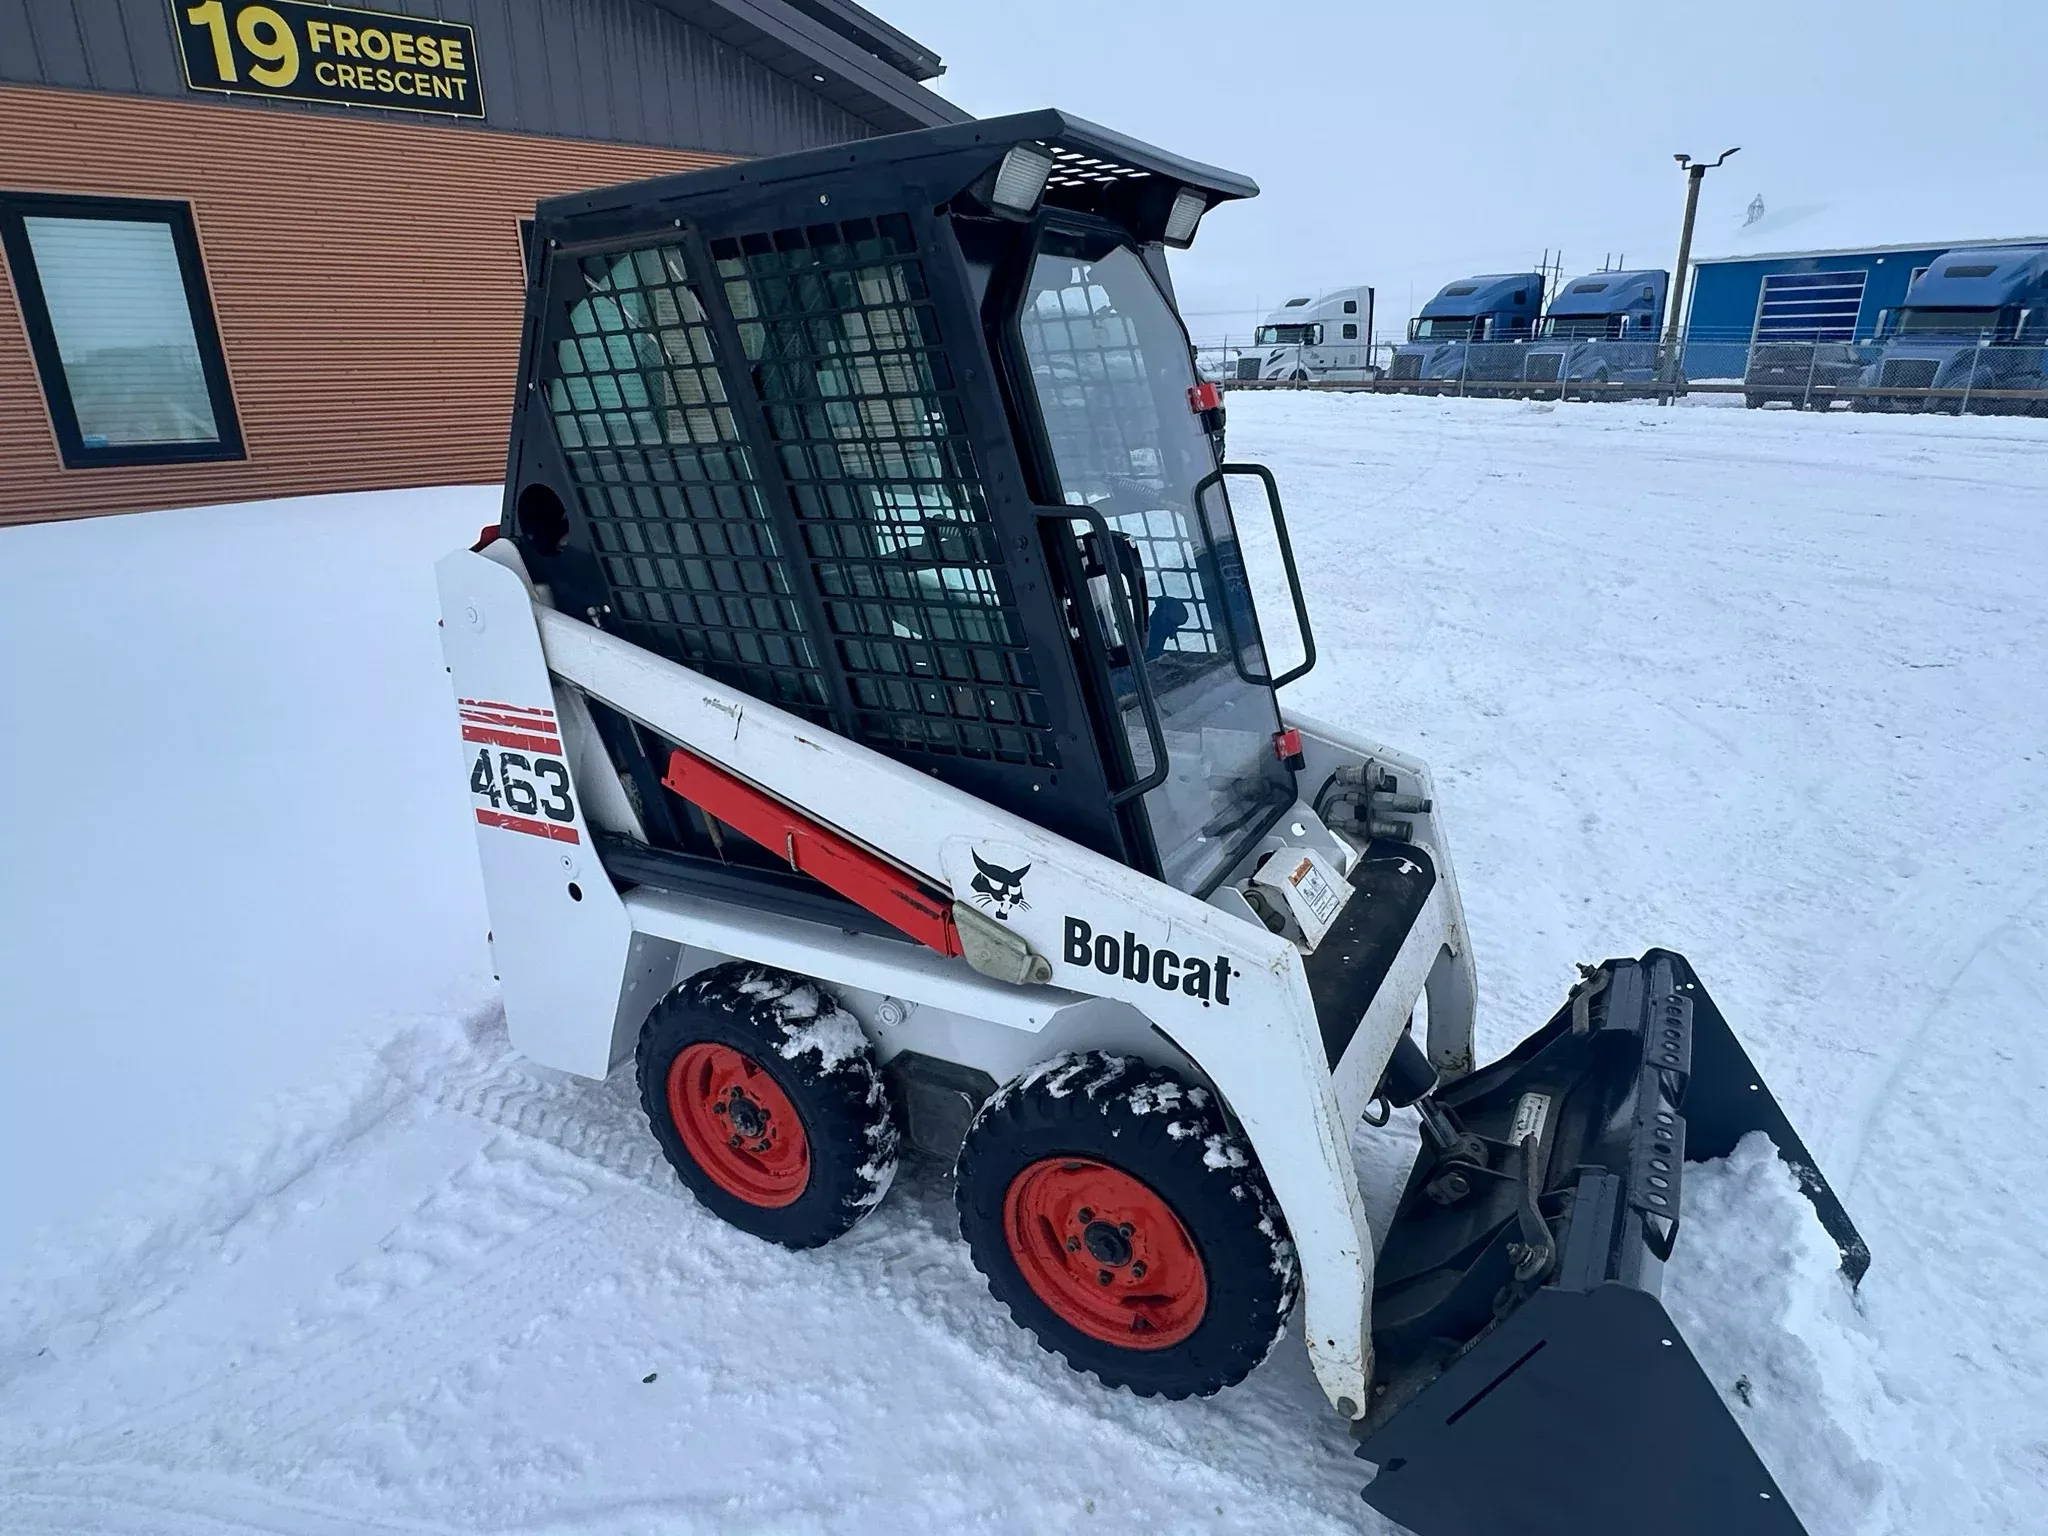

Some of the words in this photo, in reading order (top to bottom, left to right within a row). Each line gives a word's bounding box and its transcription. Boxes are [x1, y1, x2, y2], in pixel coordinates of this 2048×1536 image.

[187, 2, 299, 87] 19
[307, 21, 465, 70] FROESE
[315, 62, 467, 100] CRESCENT
[471, 748, 574, 822] 463
[1064, 915, 1231, 1006] Bobcat
